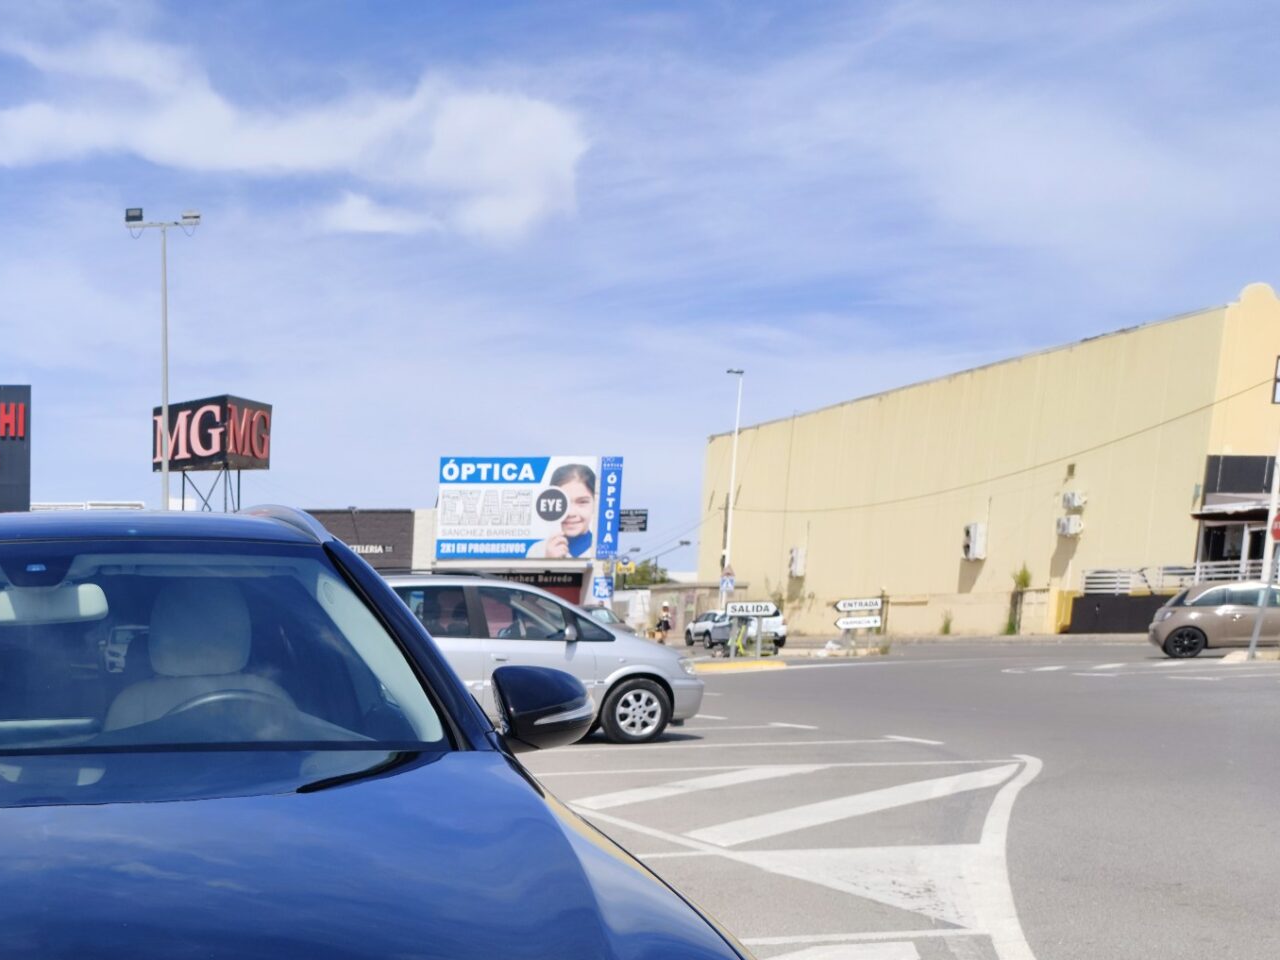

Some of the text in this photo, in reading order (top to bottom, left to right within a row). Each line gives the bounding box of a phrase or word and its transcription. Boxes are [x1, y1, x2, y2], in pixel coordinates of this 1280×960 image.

[153, 404, 224, 463] MG
[227, 403, 270, 460] MG
[442, 459, 535, 481] ÓPTICA
[539, 498, 563, 512] EYE
[486, 528, 531, 537] BARREDO
[440, 542, 526, 554] 2X1 EN PROGRESIVOS
[730, 604, 770, 613] SALIDA
[842, 600, 880, 609] ENTRADA
